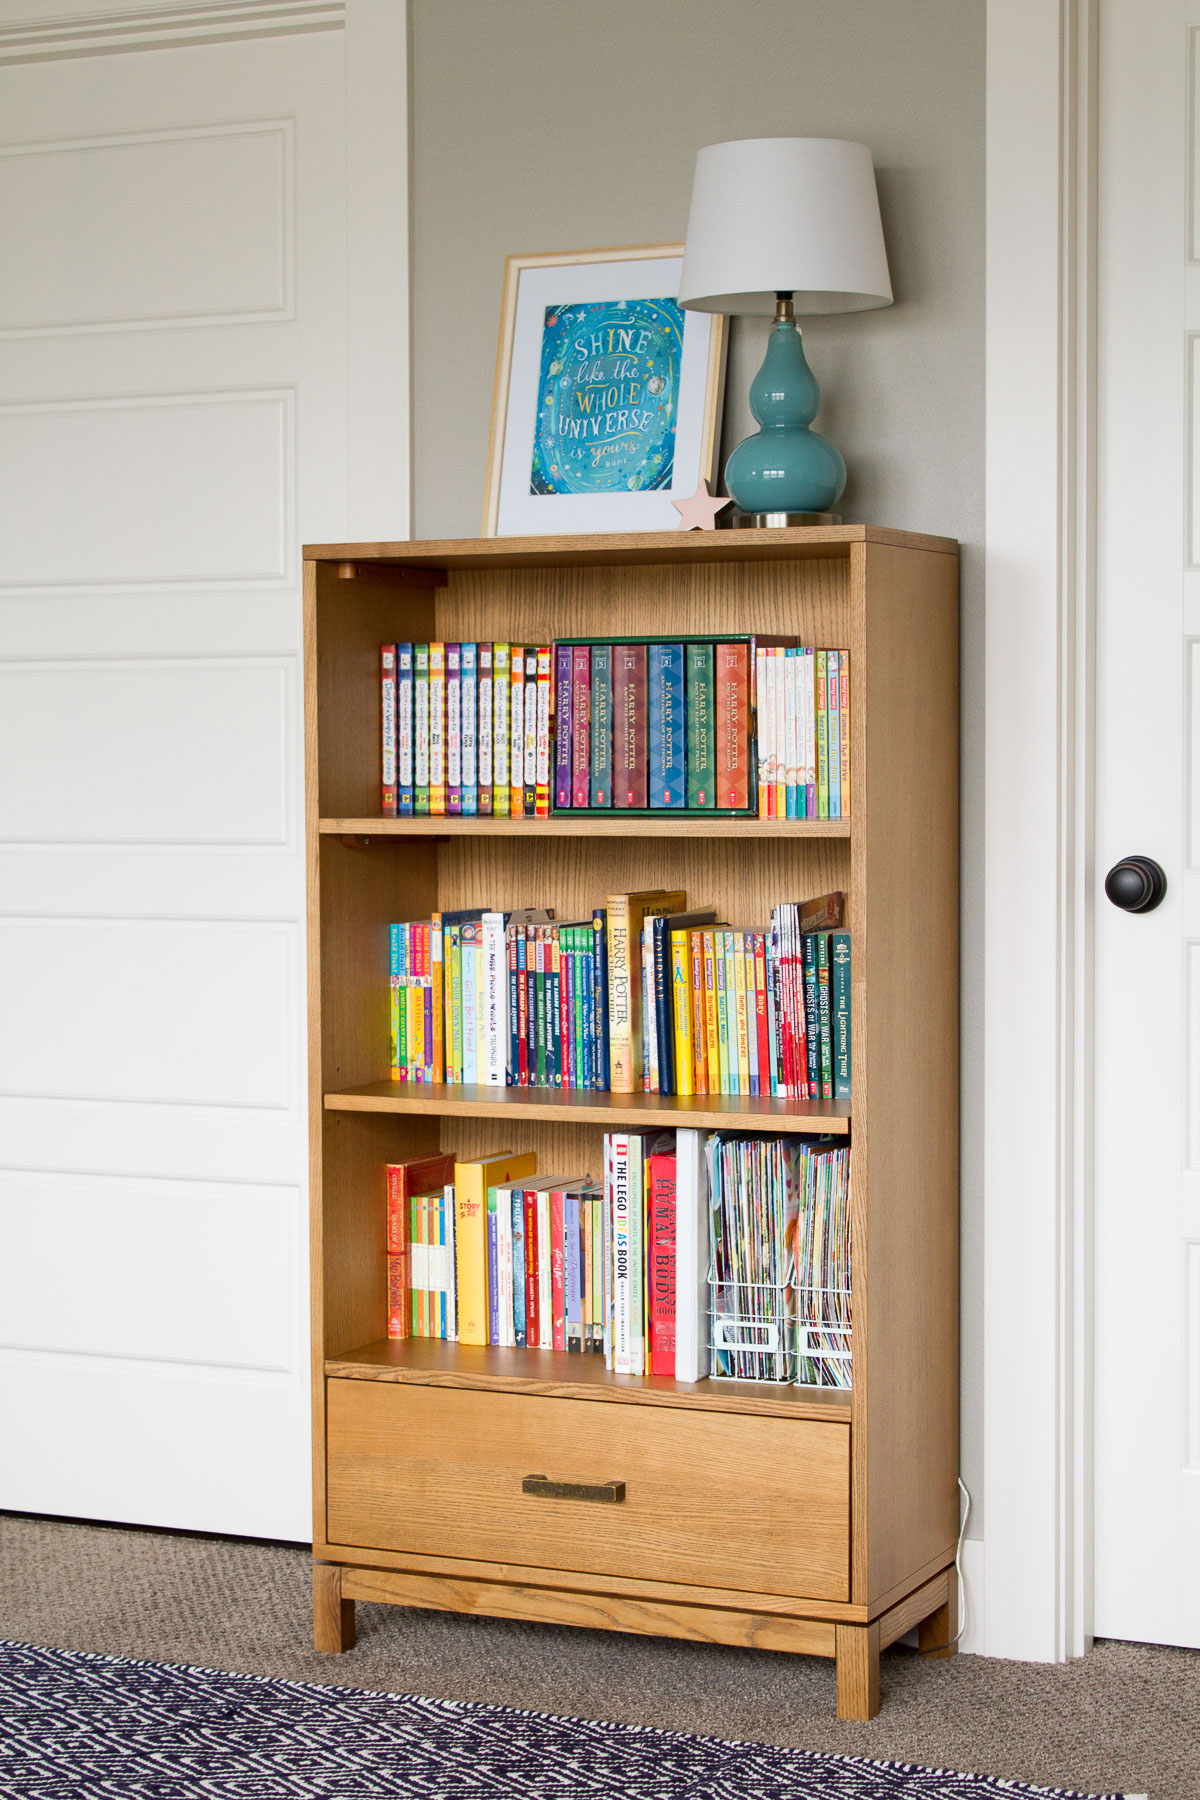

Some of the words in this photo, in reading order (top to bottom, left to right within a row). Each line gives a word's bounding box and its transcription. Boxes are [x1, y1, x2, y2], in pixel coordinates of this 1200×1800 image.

[575, 328, 651, 361] SHINE
[573, 360, 605, 383] like
[610, 359, 639, 380] the
[576, 383, 640, 413] WHOLE
[559, 409, 655, 439] UNIVERSE
[570, 446, 585, 460] is
[590, 440, 640, 467] yours
[614, 928, 626, 972] HARRY
[616, 976, 628, 1026] POTTER
[807, 984, 816, 1012] GHOSTS
[820, 986, 829, 1014] GHOSTS
[807, 1014, 816, 1022] of
[820, 1016, 829, 1024] of
[838, 1011, 848, 1052] LIGHTNING
[807, 1024, 816, 1041] WAR
[820, 1026, 829, 1042] WAR
[838, 1054, 848, 1078] THIEF
[617, 1161, 627, 1181] THE
[617, 1184, 627, 1211] LEGO
[655, 1178, 669, 1246] HUMAN
[392, 1234, 397, 1242] OF
[617, 1216, 627, 1246] IDEAS
[617, 1249, 627, 1279] BOOK
[655, 1254, 669, 1305] BODY
